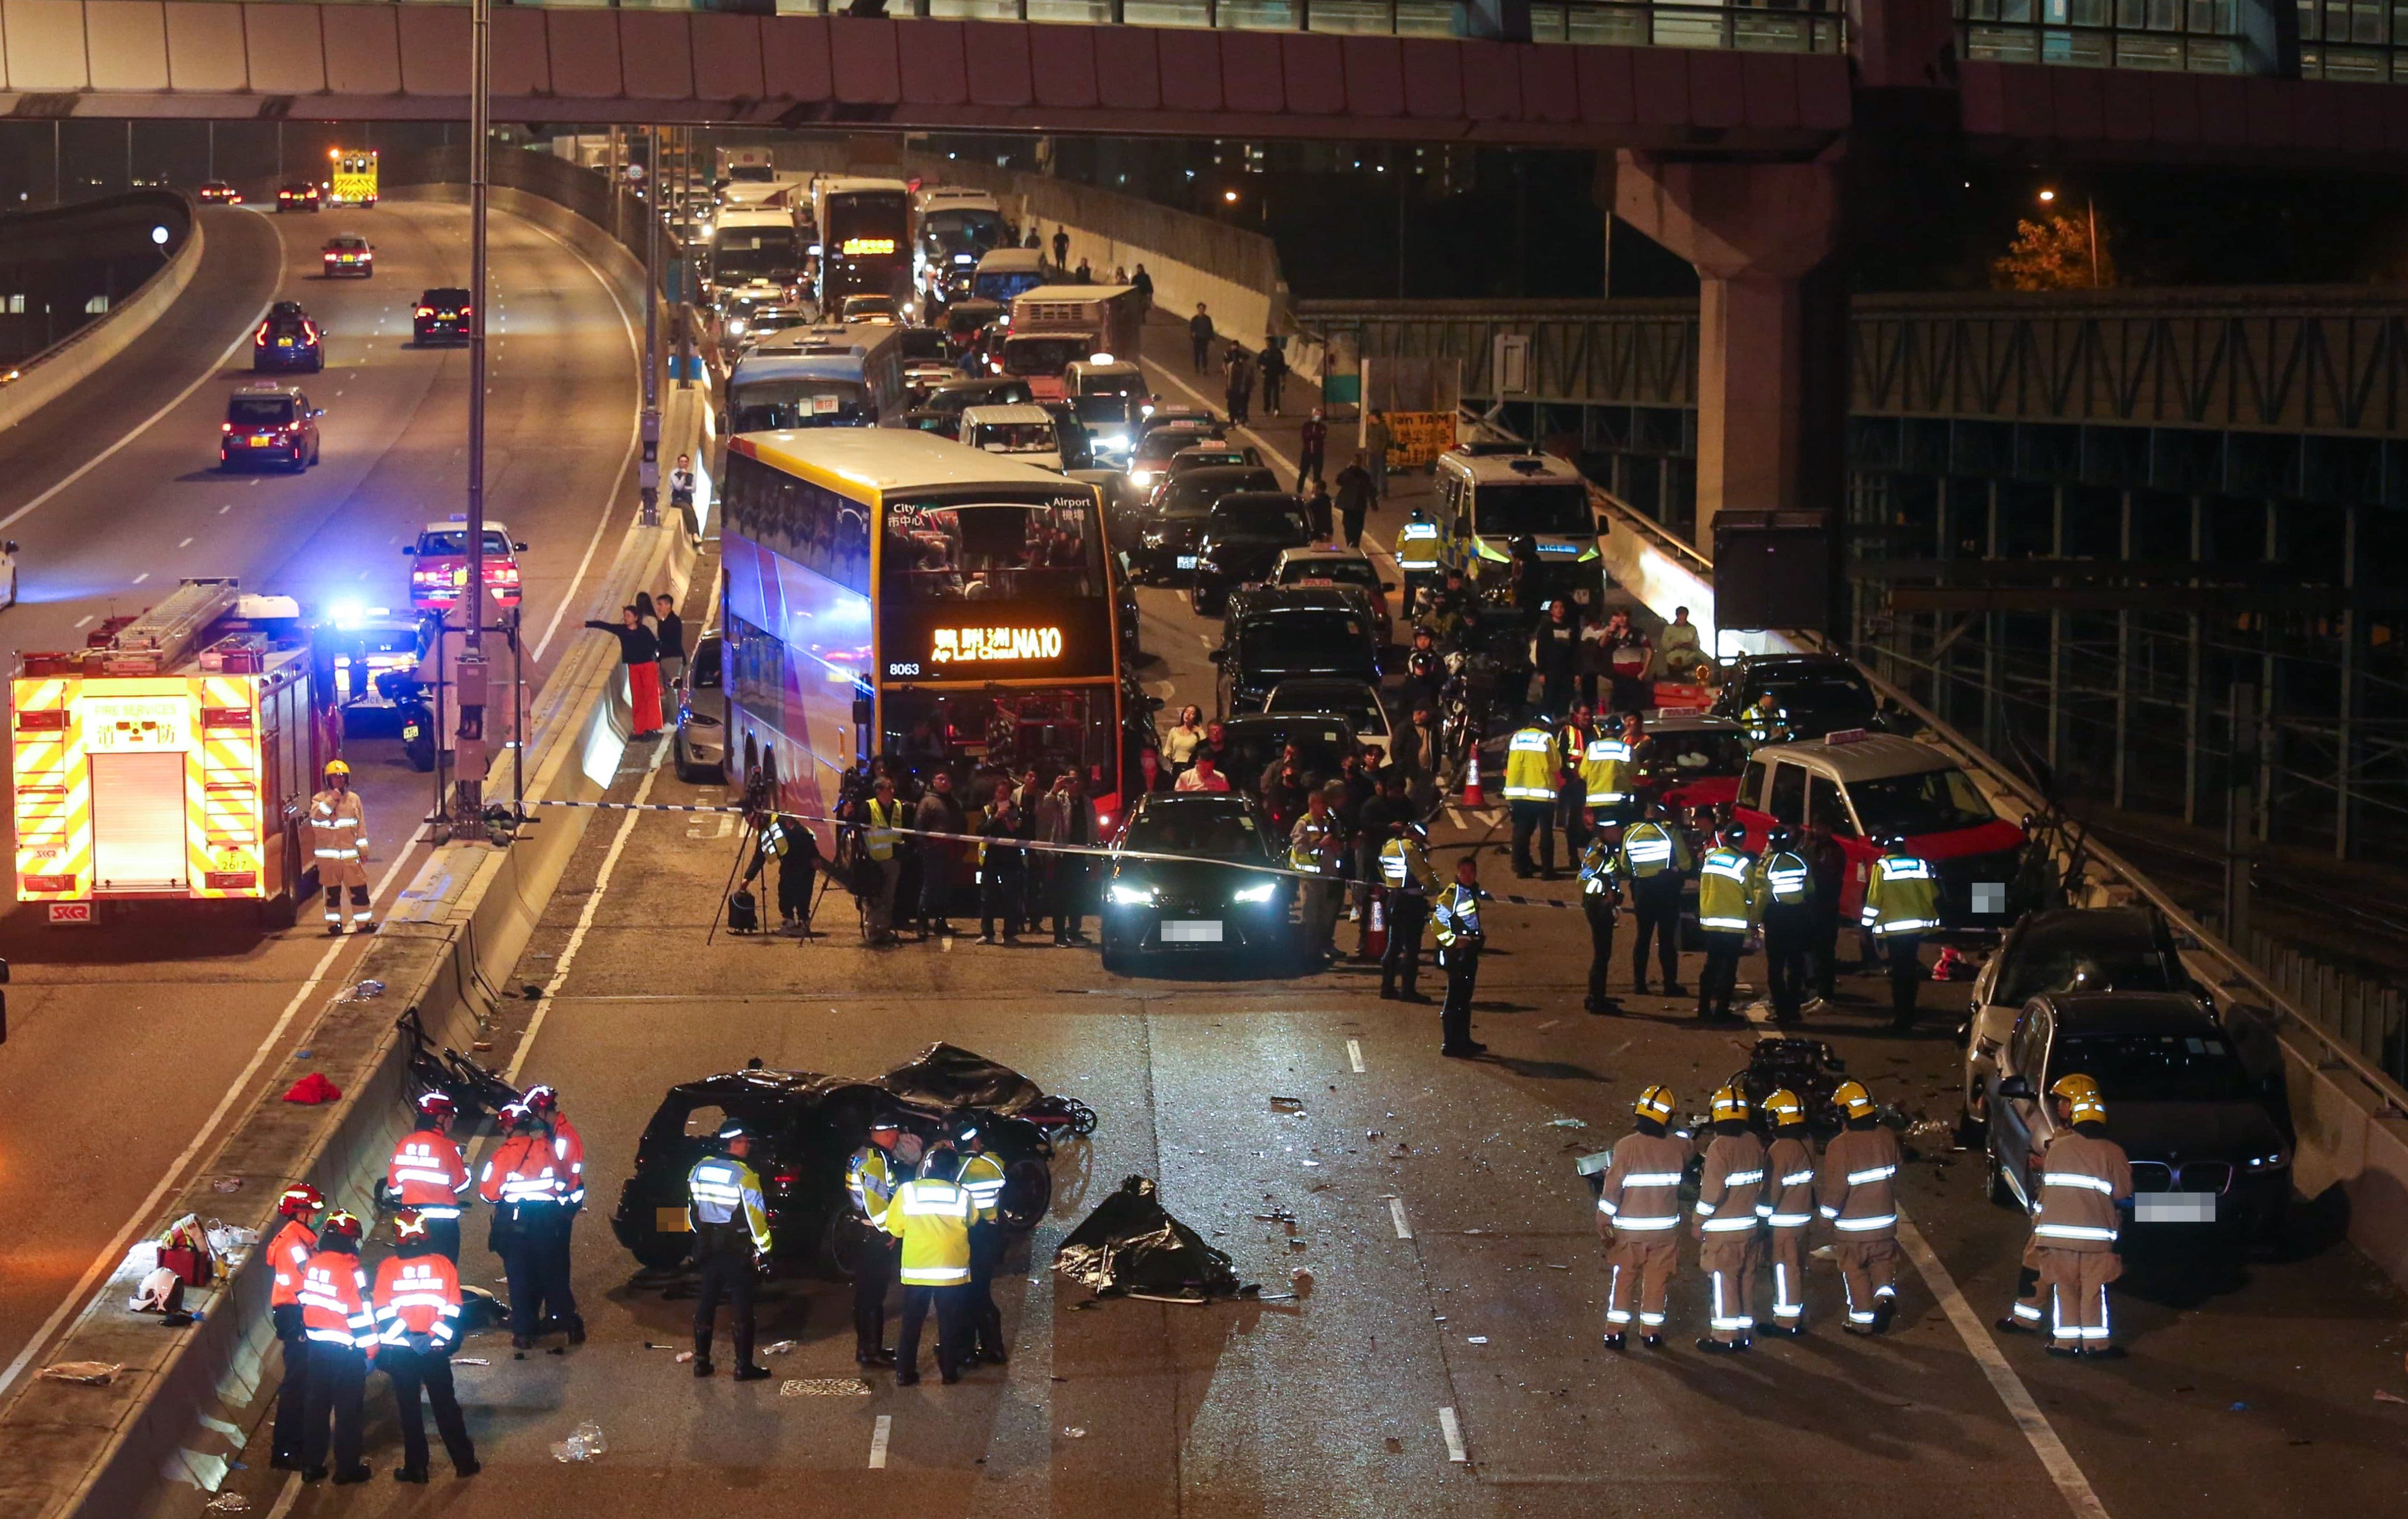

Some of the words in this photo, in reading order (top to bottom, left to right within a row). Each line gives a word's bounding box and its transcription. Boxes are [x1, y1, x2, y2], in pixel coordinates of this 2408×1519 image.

[893, 503, 915, 515] City
[1053, 497, 1091, 509] Airport
[888, 515, 925, 528] 市中心
[1012, 627, 1062, 658] NA10
[931, 648, 951, 663] Ap
[889, 663, 919, 676] 8063
[95, 705, 118, 715] FIRE
[122, 704, 176, 715] SERVICES
[222, 861, 247, 871] 2617
